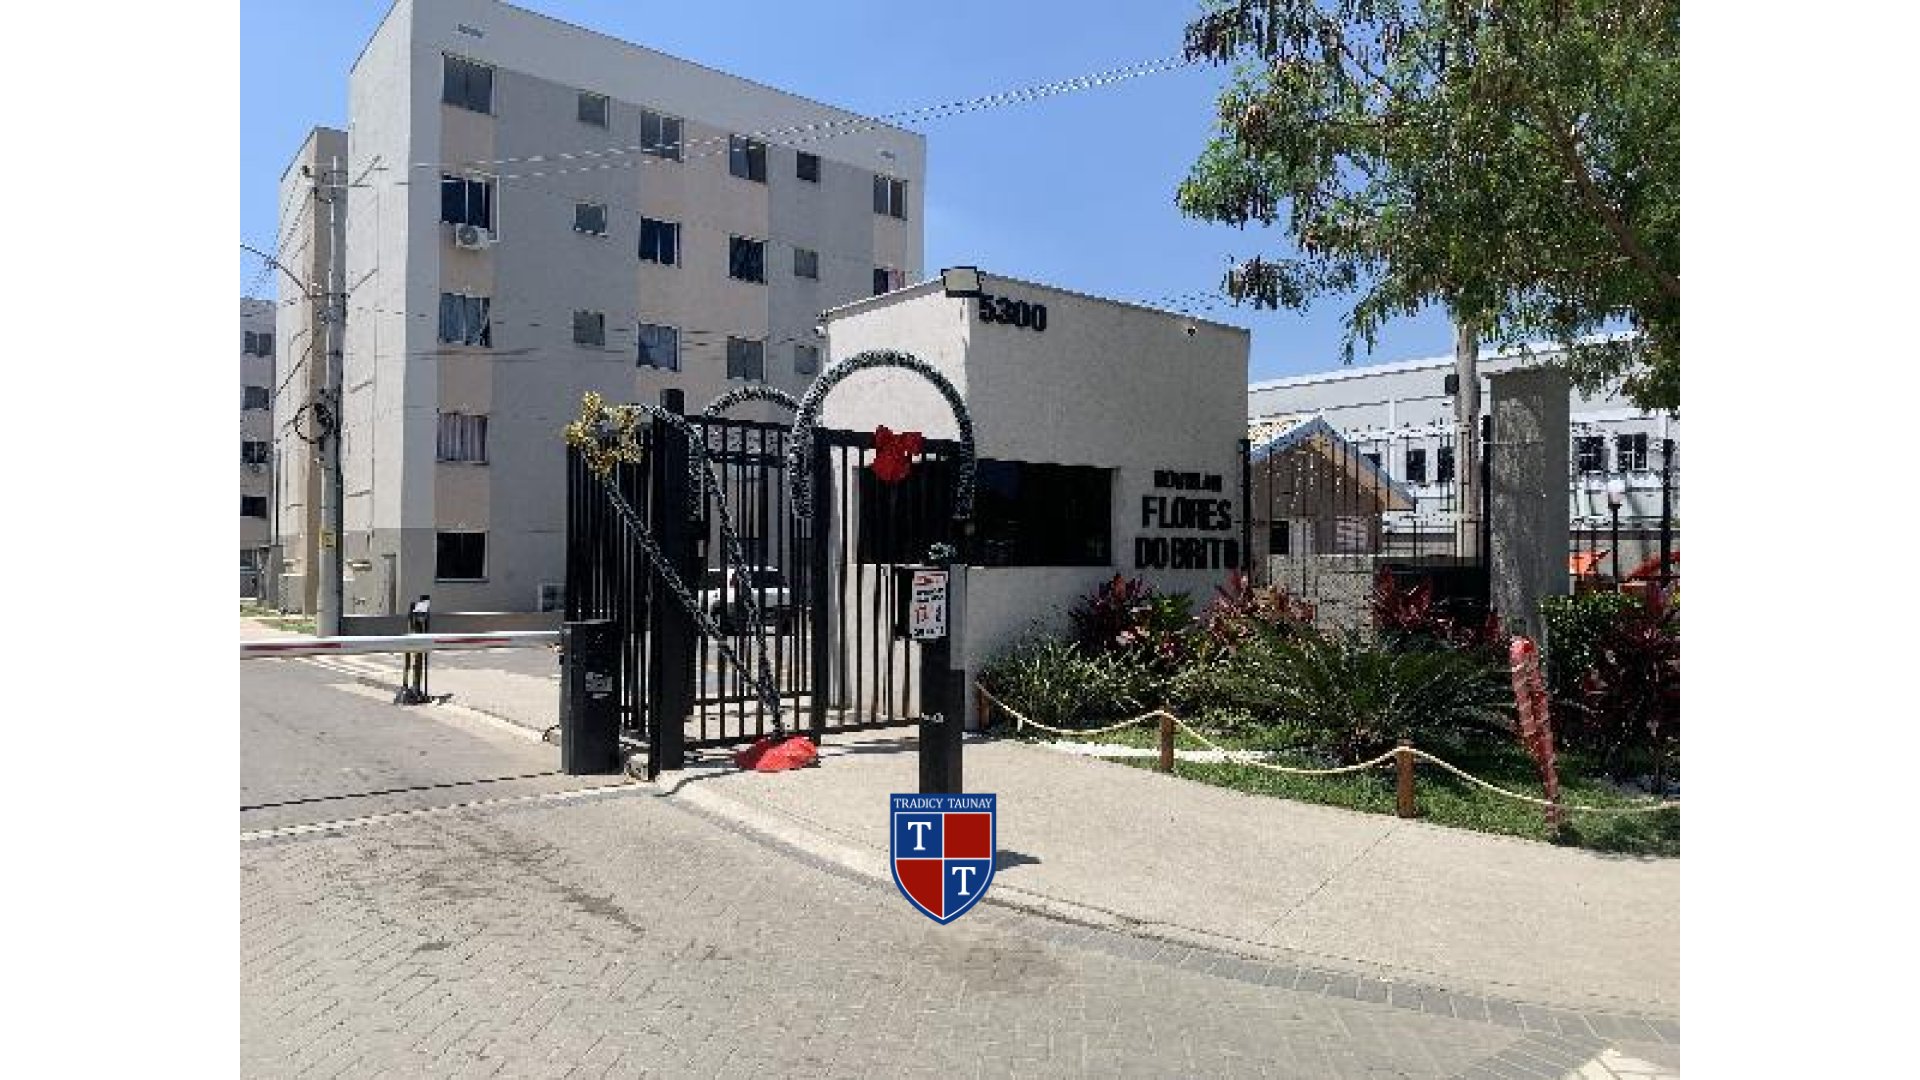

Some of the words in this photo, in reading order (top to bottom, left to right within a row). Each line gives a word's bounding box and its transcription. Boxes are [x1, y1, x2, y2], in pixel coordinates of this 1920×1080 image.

[979, 298, 1046, 331] 5300
[1142, 496, 1231, 530] FLORES
[1135, 537, 1168, 569] DO
